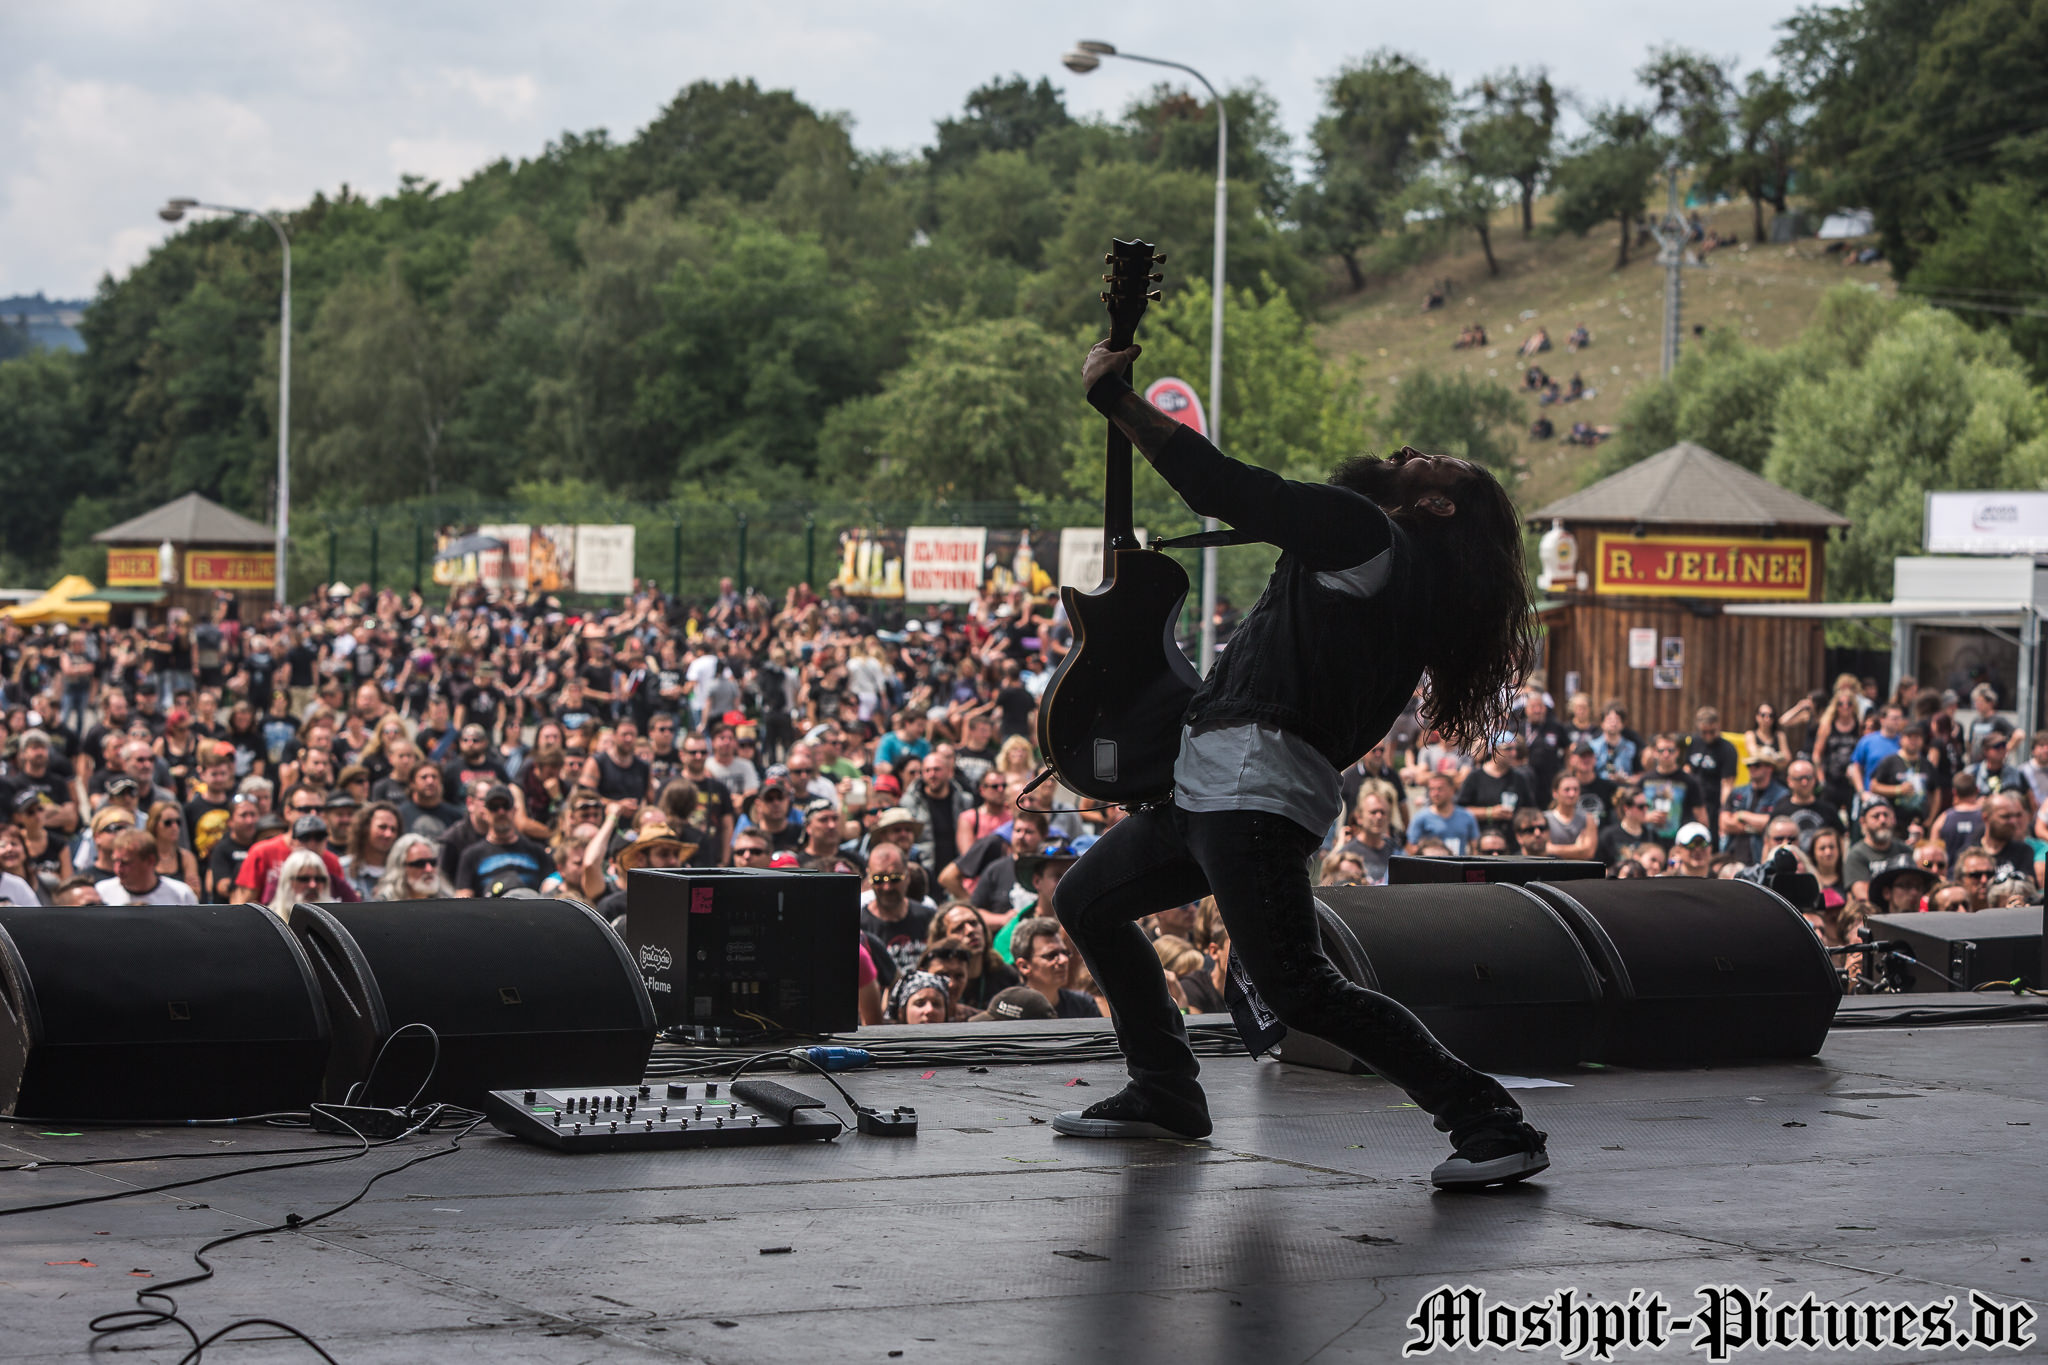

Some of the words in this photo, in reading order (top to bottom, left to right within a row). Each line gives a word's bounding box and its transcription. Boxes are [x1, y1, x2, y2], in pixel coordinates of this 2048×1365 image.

[1608, 549, 1645, 580] R.
[1655, 546, 1804, 584] JELÍNEK
[641, 975, 672, 993] -Flame
